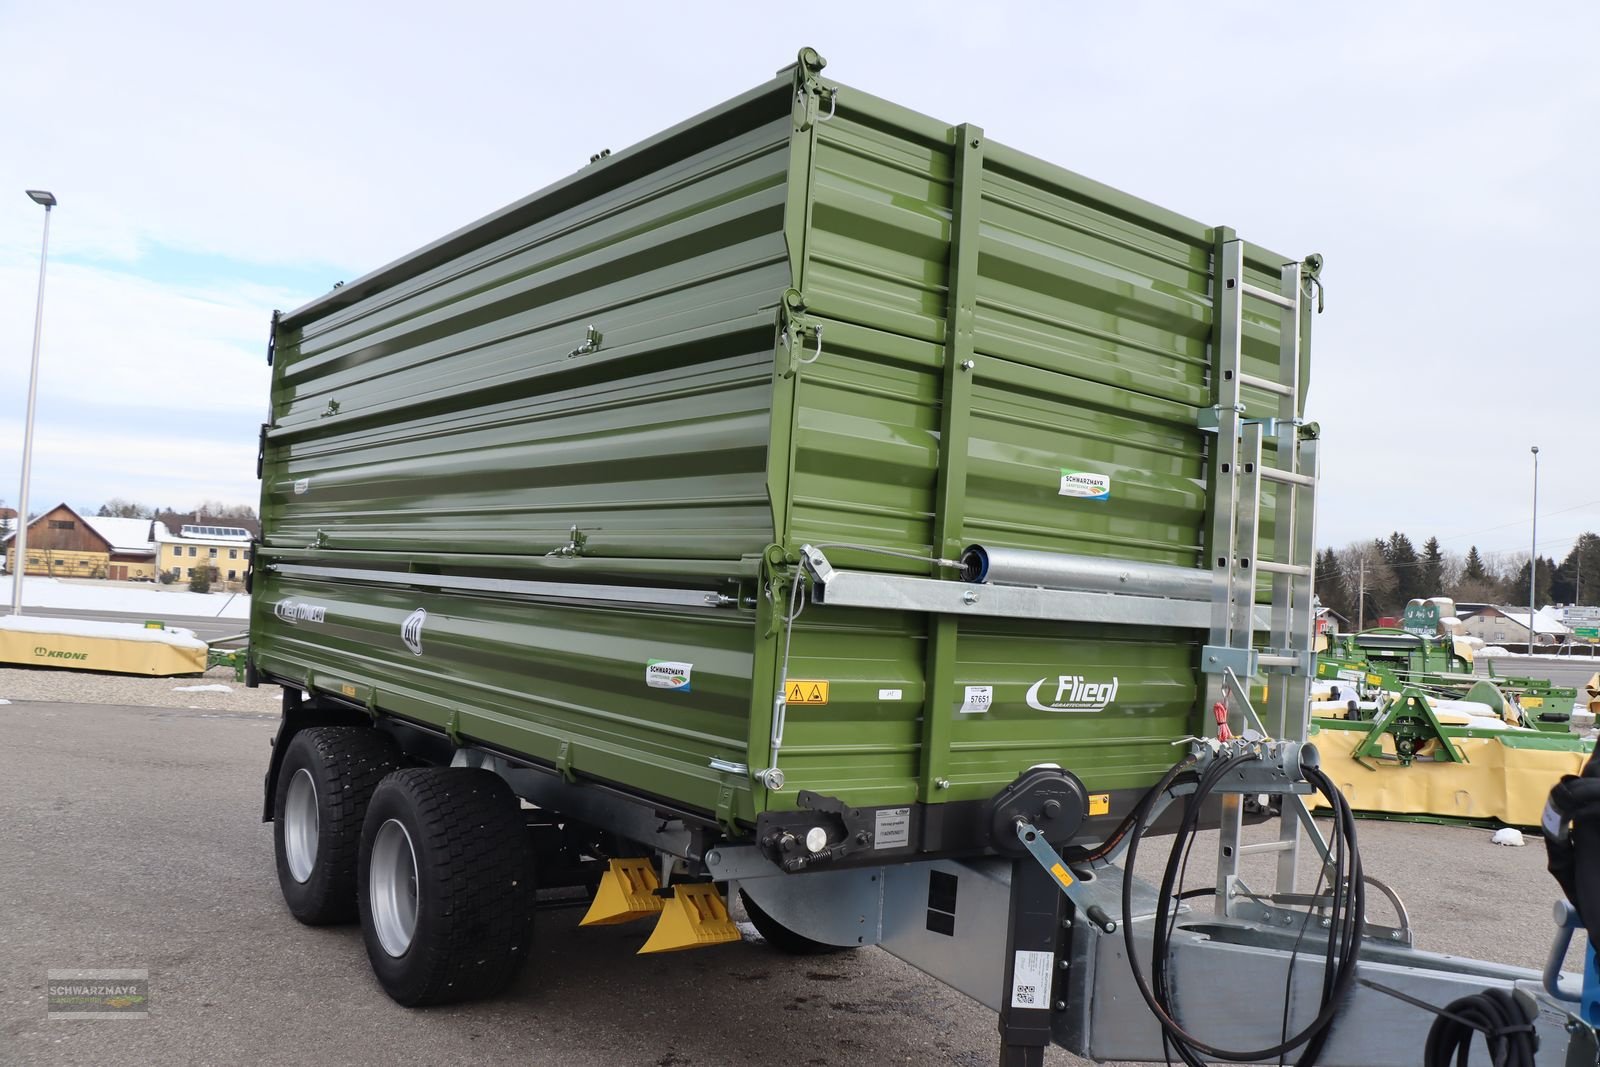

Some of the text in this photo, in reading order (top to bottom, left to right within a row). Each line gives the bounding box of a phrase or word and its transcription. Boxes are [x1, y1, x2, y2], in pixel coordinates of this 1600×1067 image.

[1065, 475, 1104, 486] SCHWARZMAYR
[47, 650, 88, 660] KRONE
[650, 665, 684, 675] SCHWARZMAYR
[1054, 675, 1119, 703] Fliegl
[971, 695, 989, 703] 57651
